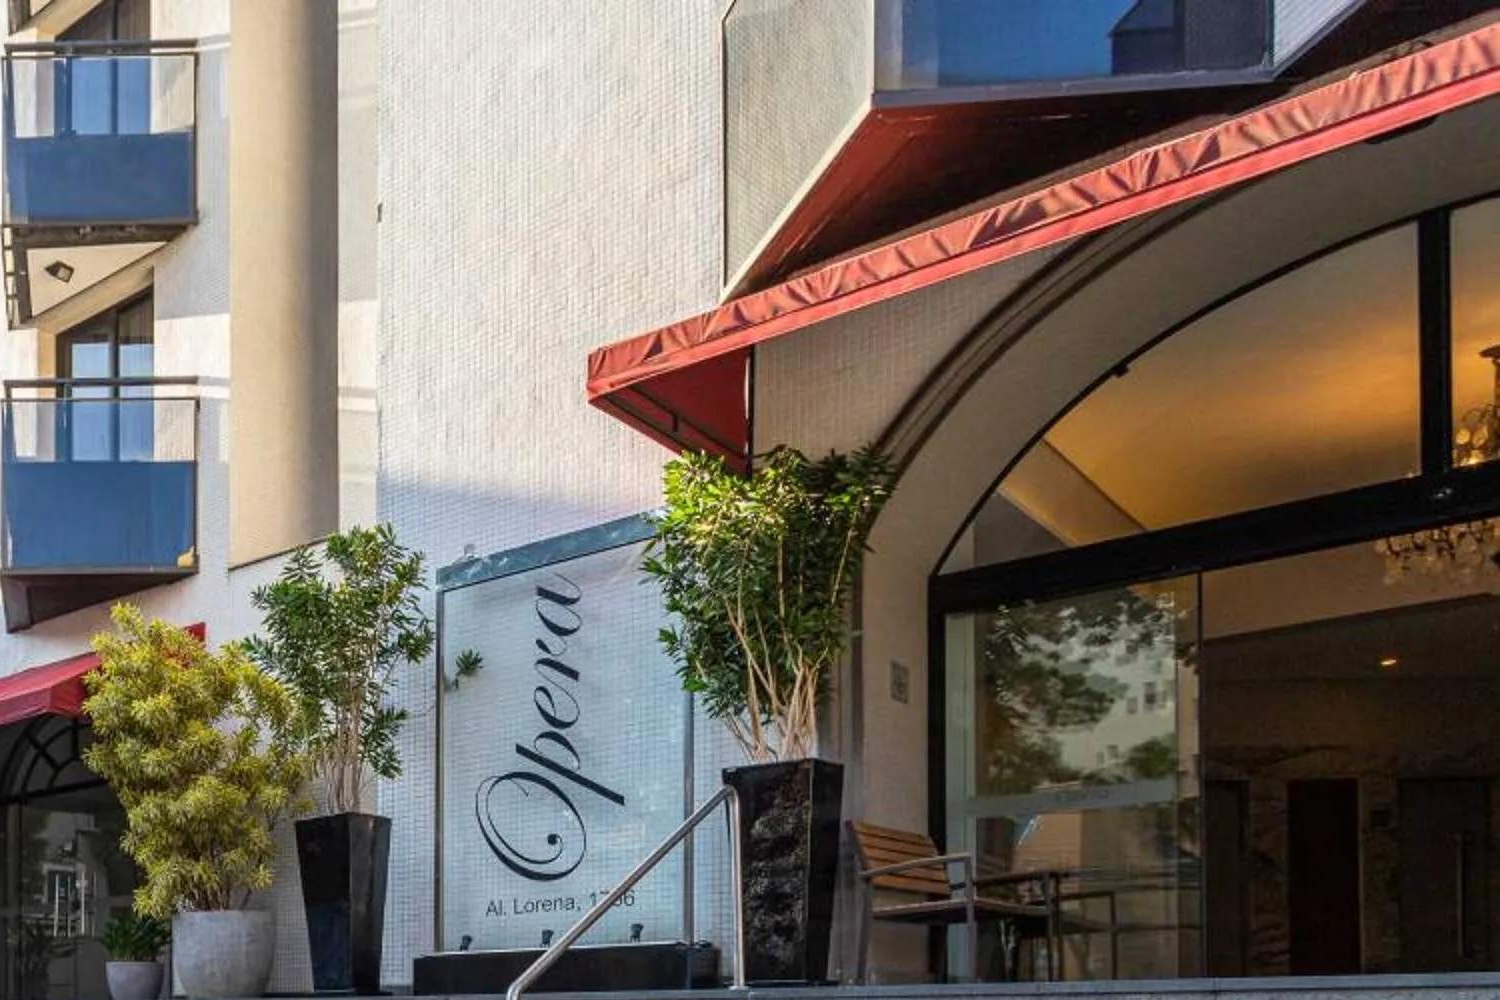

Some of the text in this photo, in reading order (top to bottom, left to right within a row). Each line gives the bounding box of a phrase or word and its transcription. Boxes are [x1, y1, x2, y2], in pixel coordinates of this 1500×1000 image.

[476, 573, 625, 882] Opera
[486, 899, 507, 917] Al.
[513, 896, 581, 915] Lorena,
